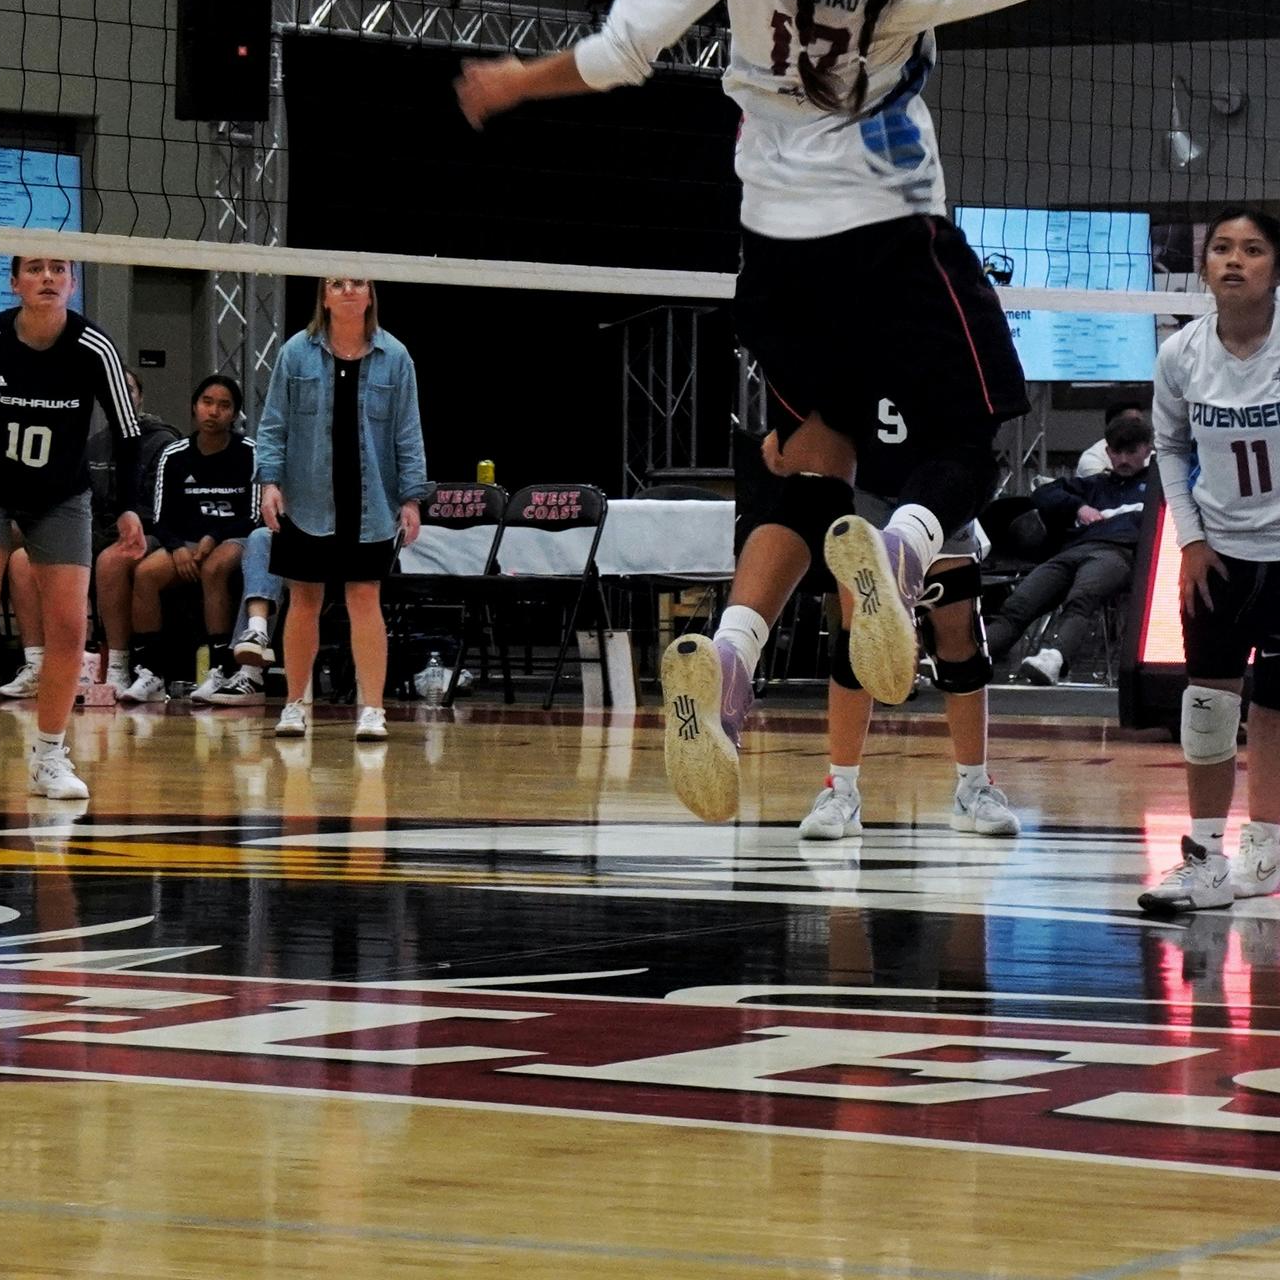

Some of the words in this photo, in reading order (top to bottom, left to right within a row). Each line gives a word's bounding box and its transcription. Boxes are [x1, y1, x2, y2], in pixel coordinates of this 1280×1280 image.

[5, 422, 52, 468] 10
[1230, 439, 1273, 498] 11
[436, 489, 487, 505] WEST
[530, 490, 582, 507] WEST
[427, 502, 488, 519] COAST
[522, 505, 583, 521] COAST
